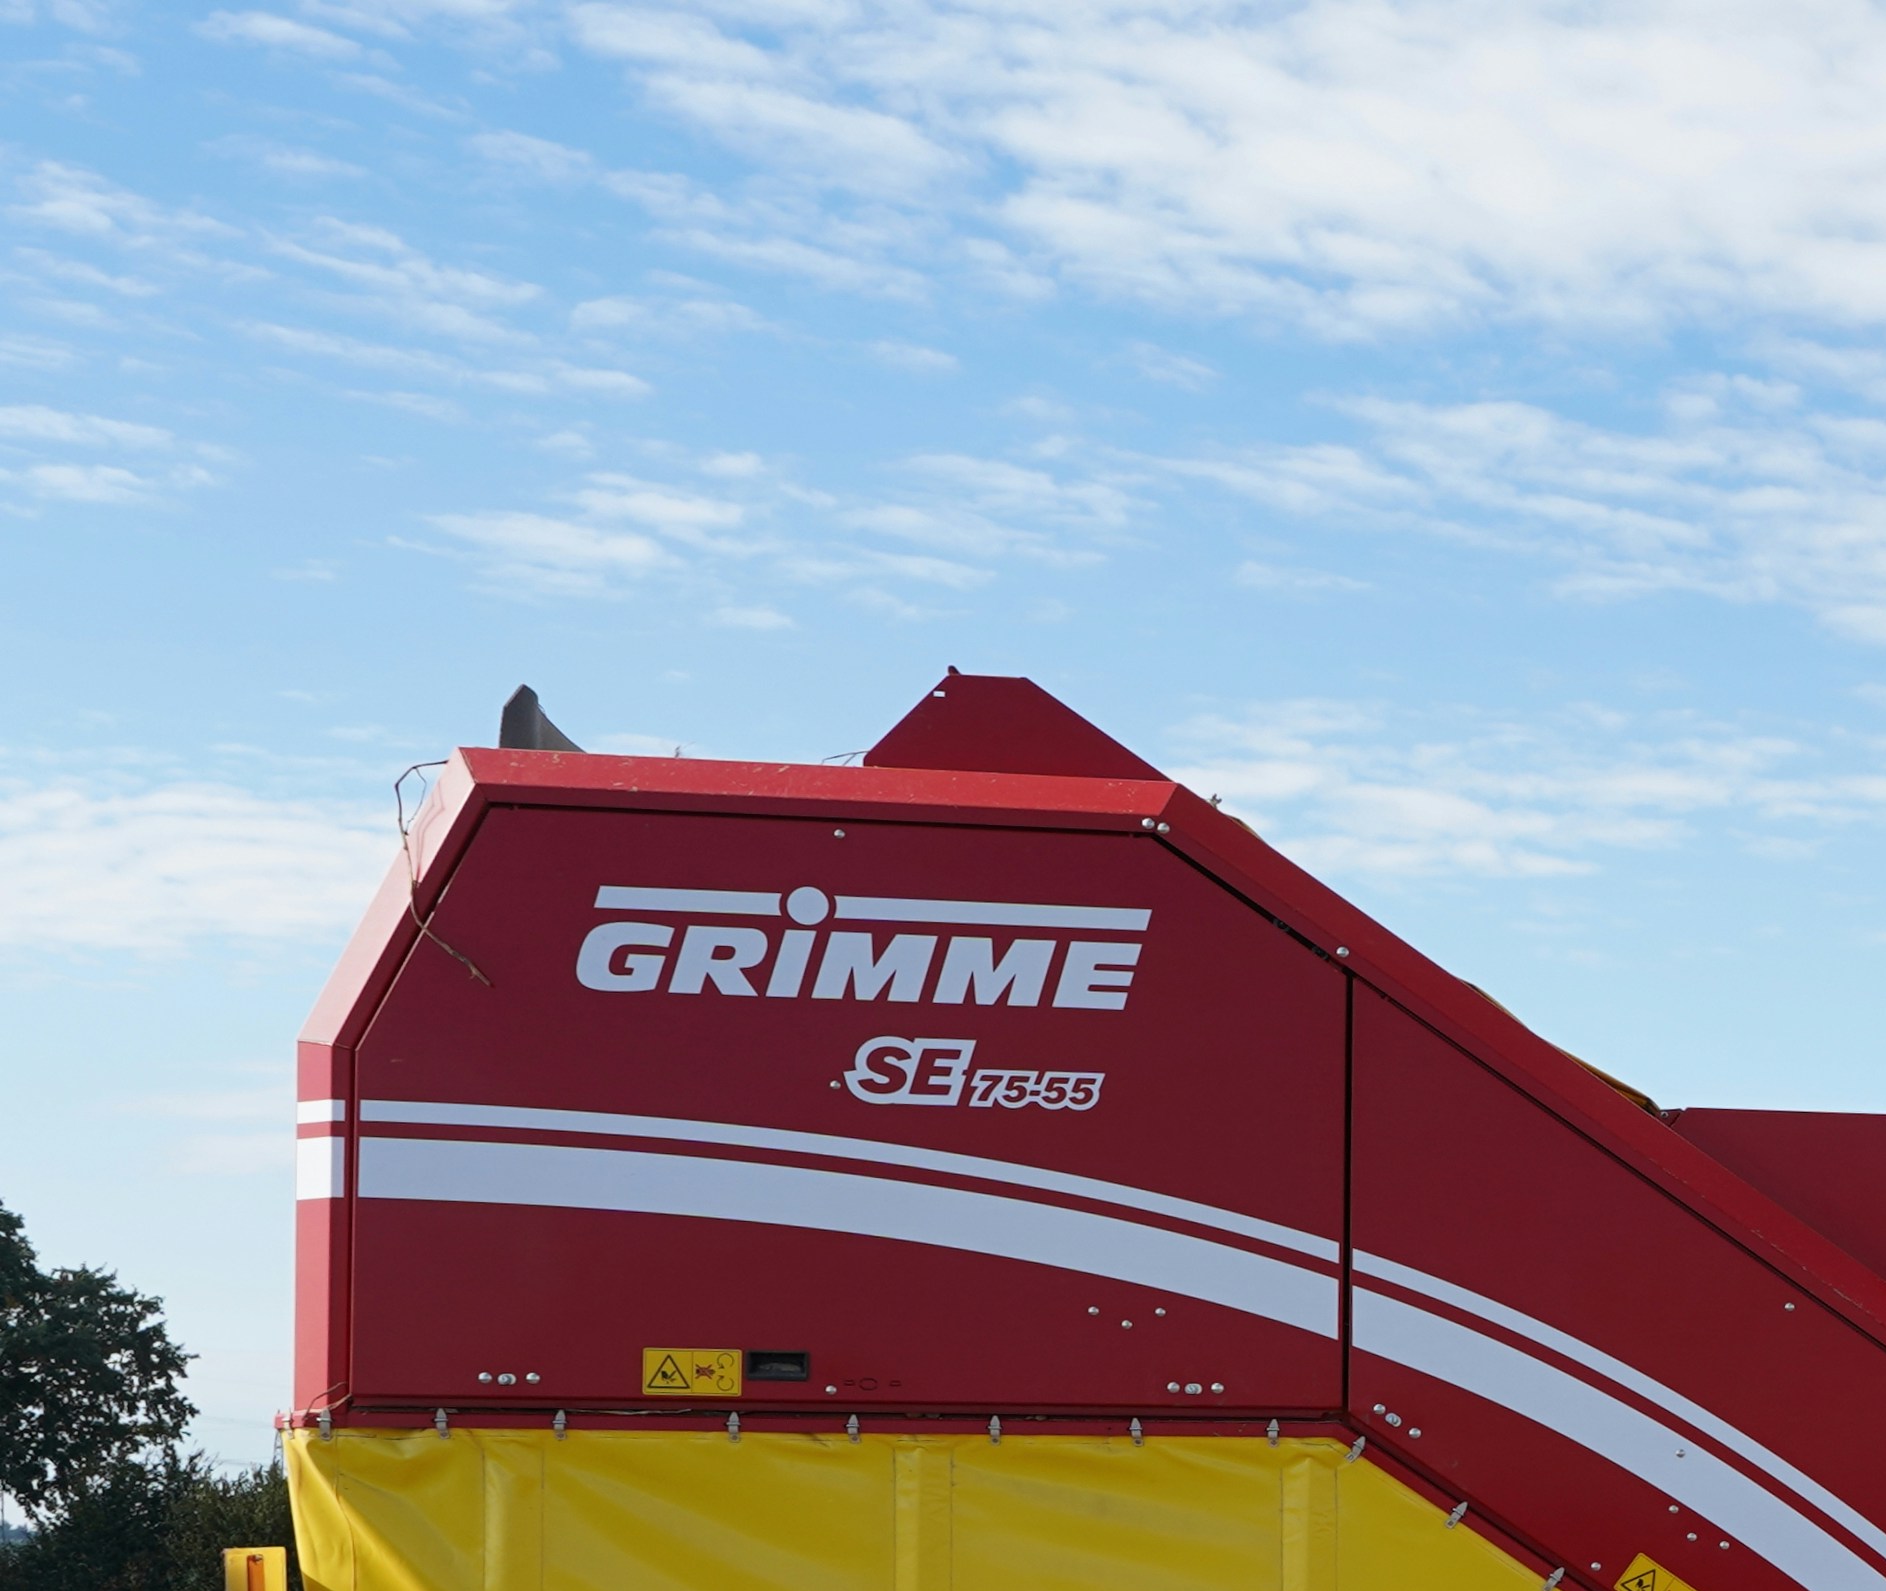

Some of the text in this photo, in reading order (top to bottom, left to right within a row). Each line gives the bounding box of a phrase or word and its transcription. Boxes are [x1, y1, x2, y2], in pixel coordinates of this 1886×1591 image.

[576, 886, 1144, 1011] GRIMME
[850, 1040, 1102, 1108] SE 75-55
